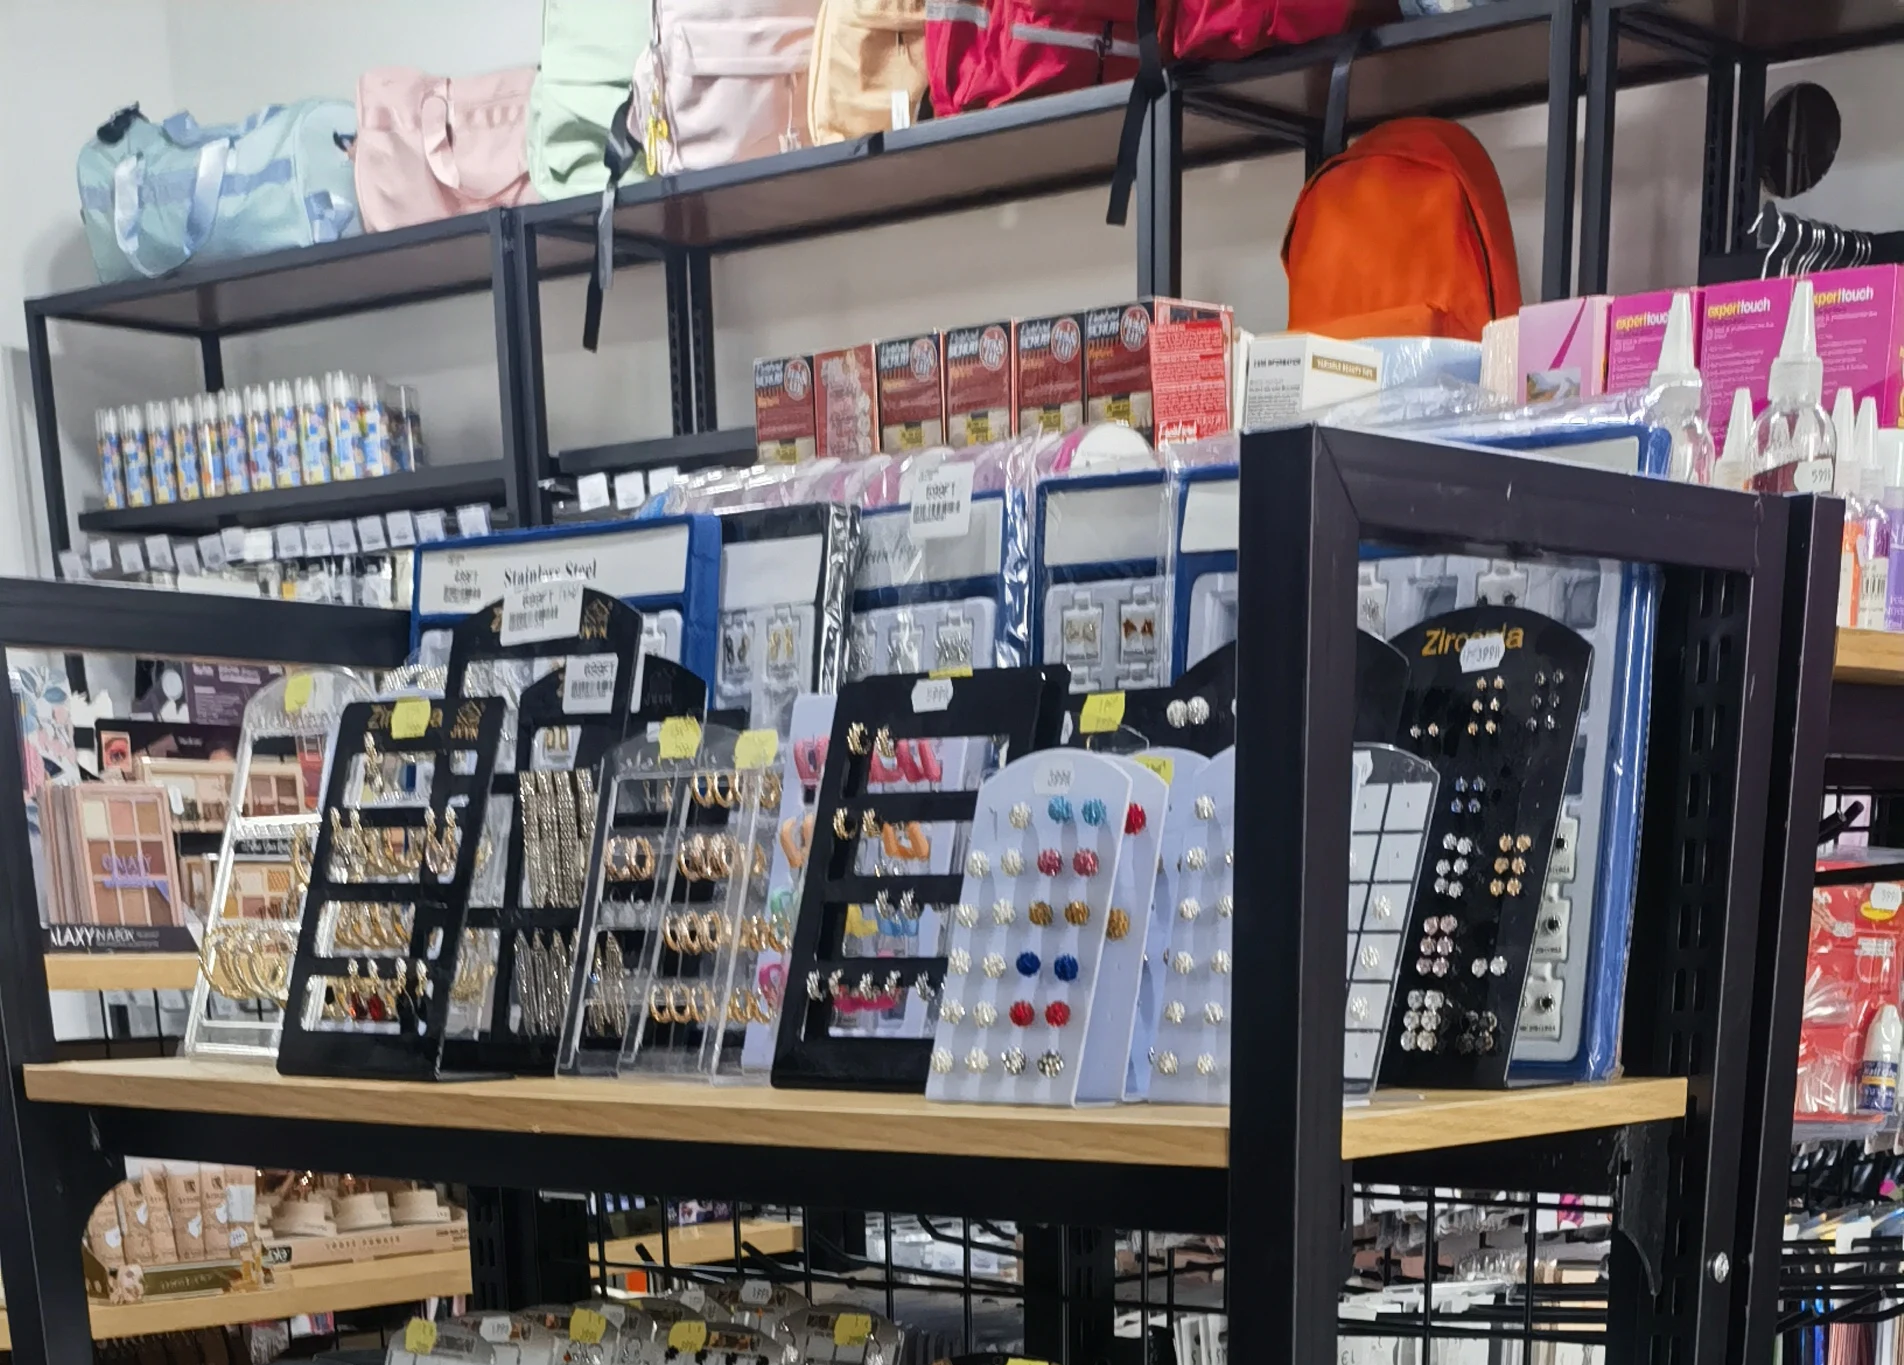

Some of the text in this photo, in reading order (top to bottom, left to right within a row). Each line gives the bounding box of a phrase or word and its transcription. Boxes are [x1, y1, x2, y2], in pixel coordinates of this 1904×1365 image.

[1813, 286, 1874, 307] xperttouch
[1707, 297, 1771, 319] experttouch
[1616, 310, 1670, 331] experttouc
[565, 557, 597, 581] Steel
